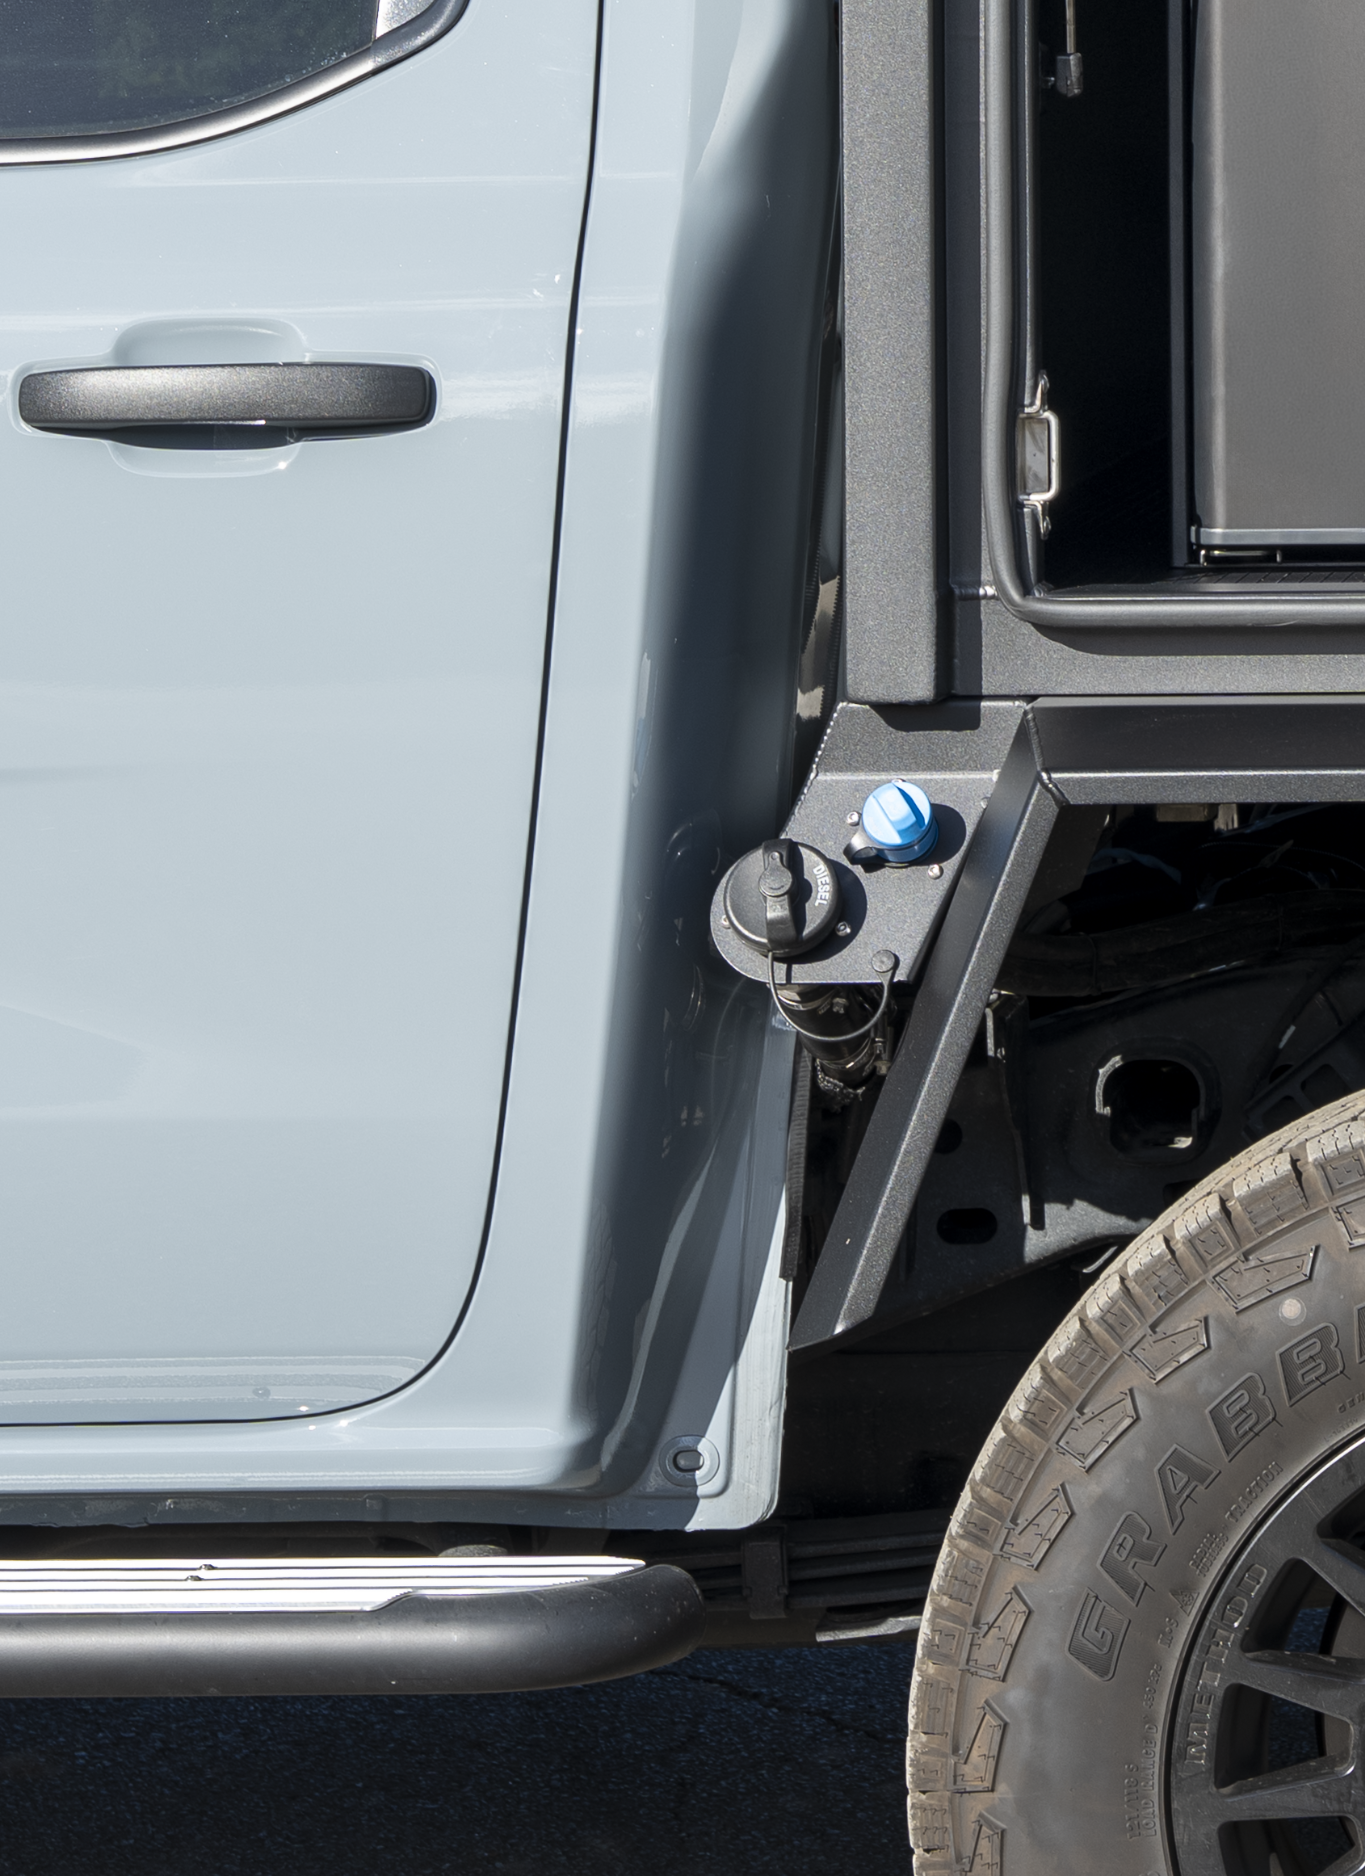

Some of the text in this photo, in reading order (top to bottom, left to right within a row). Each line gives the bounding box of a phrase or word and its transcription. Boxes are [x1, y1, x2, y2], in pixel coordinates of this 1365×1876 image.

[812, 864, 830, 906] DIESEL
[1225, 1461, 1283, 1523] TRACTION
[1184, 1563, 1268, 1765] METHOD
[1141, 1740, 1155, 1790] RANGE
[1142, 1799, 1157, 1837] LOAD
